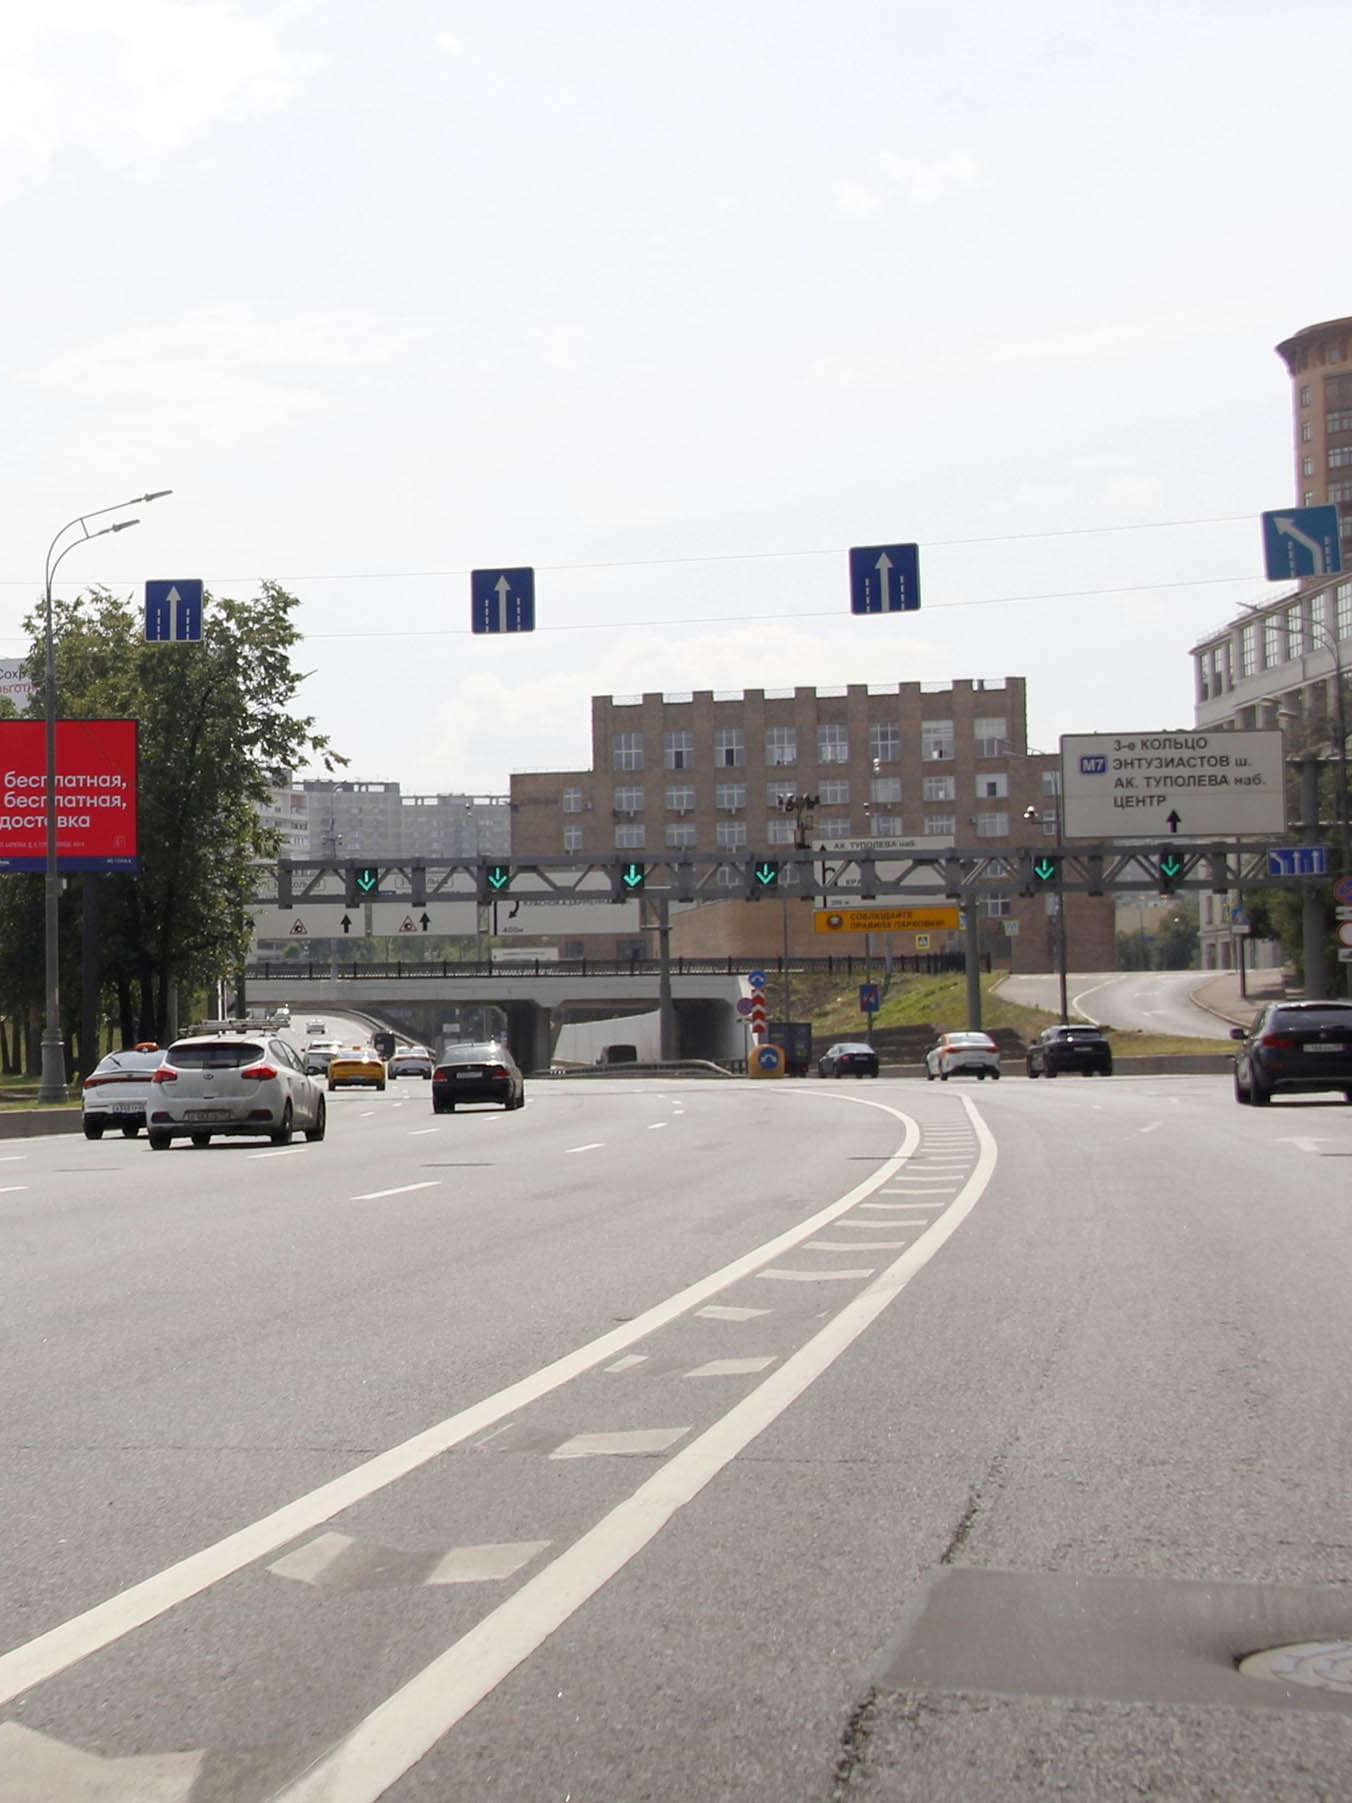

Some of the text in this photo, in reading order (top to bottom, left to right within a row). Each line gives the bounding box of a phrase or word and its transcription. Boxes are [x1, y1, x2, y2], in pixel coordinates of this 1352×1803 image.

[1140, 736, 1208, 751] КОЛЬЦО
[1113, 755, 1253, 770] ЭНТУЗИАСТОВ ш.
[1114, 772, 1267, 789] АК. ТУПОЛЕВА наб.
[1113, 795, 1166, 810] ЦЕНТР
[0, 815, 91, 831] доствка
